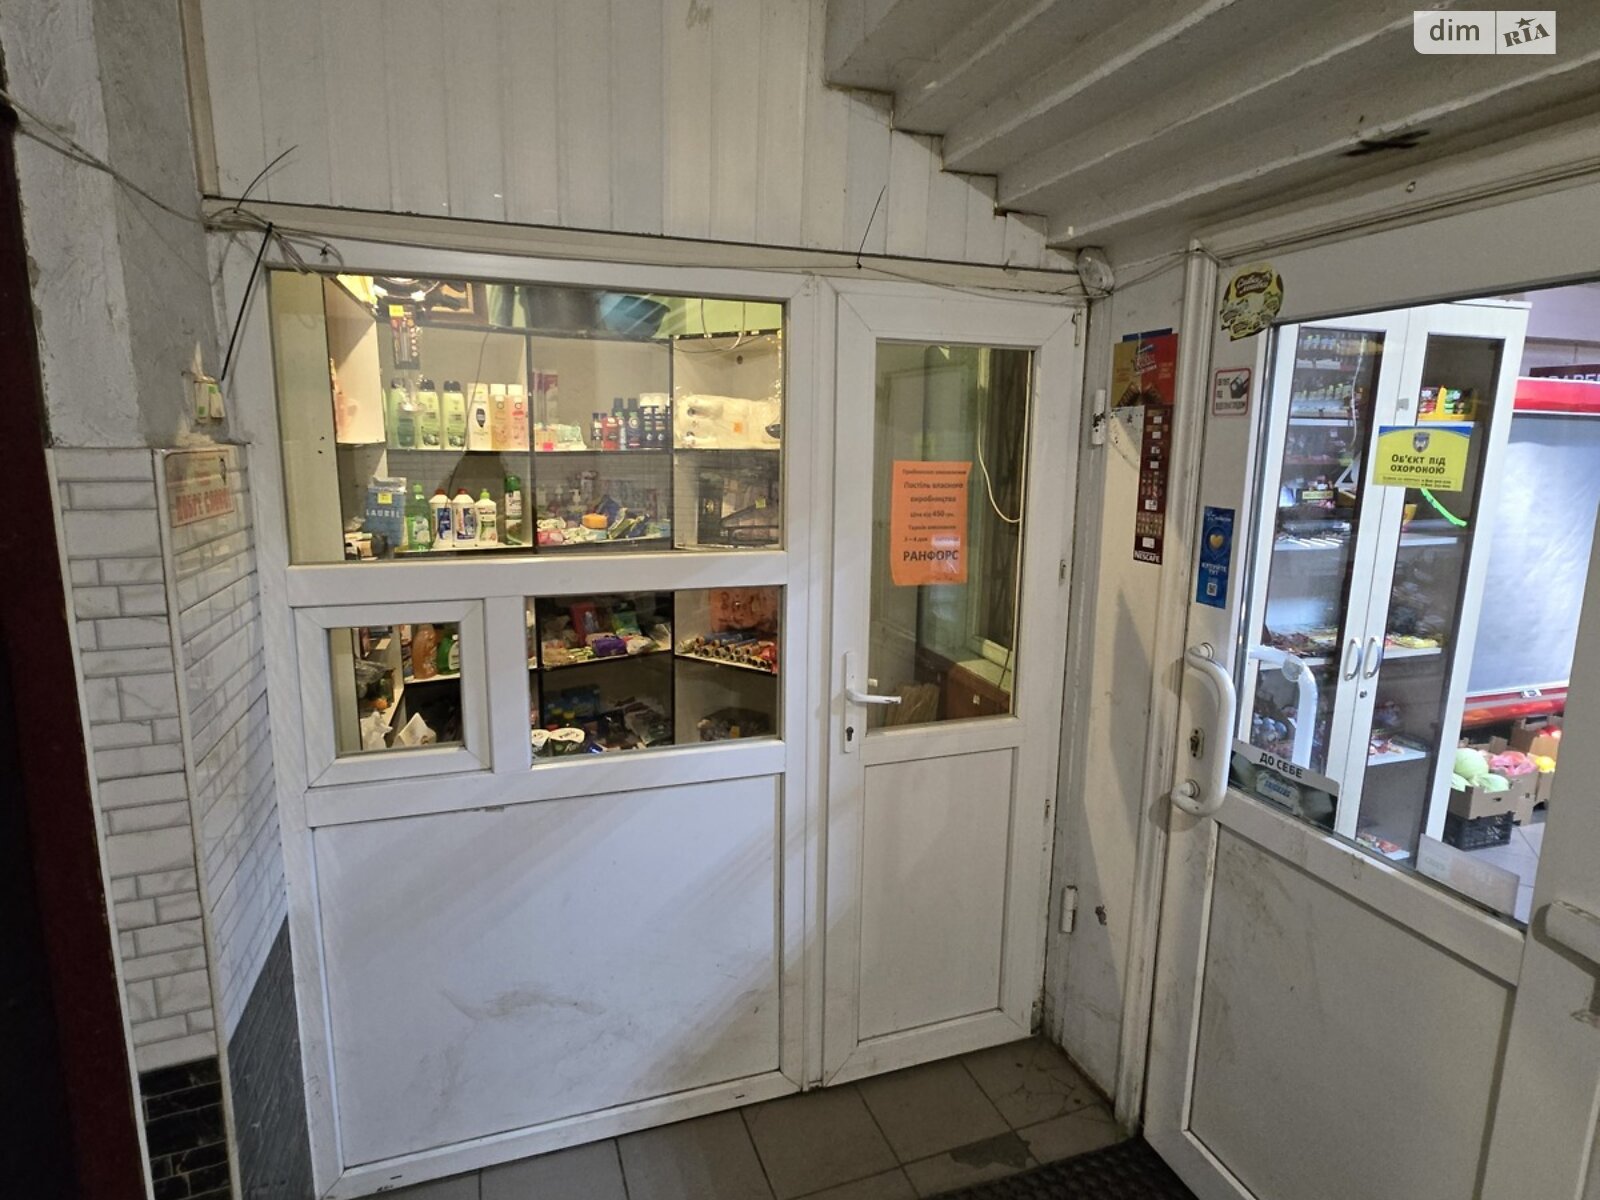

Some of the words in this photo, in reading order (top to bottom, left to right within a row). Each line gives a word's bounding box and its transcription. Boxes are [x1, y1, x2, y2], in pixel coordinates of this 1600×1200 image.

[1429, 457, 1446, 466] ПІД
[1390, 464, 1445, 474] ОХОРОНОЮ
[903, 550, 959, 561] РАНФОРС
[1260, 753, 1275, 766] ДО
[1276, 760, 1304, 778] СЕБЕ
